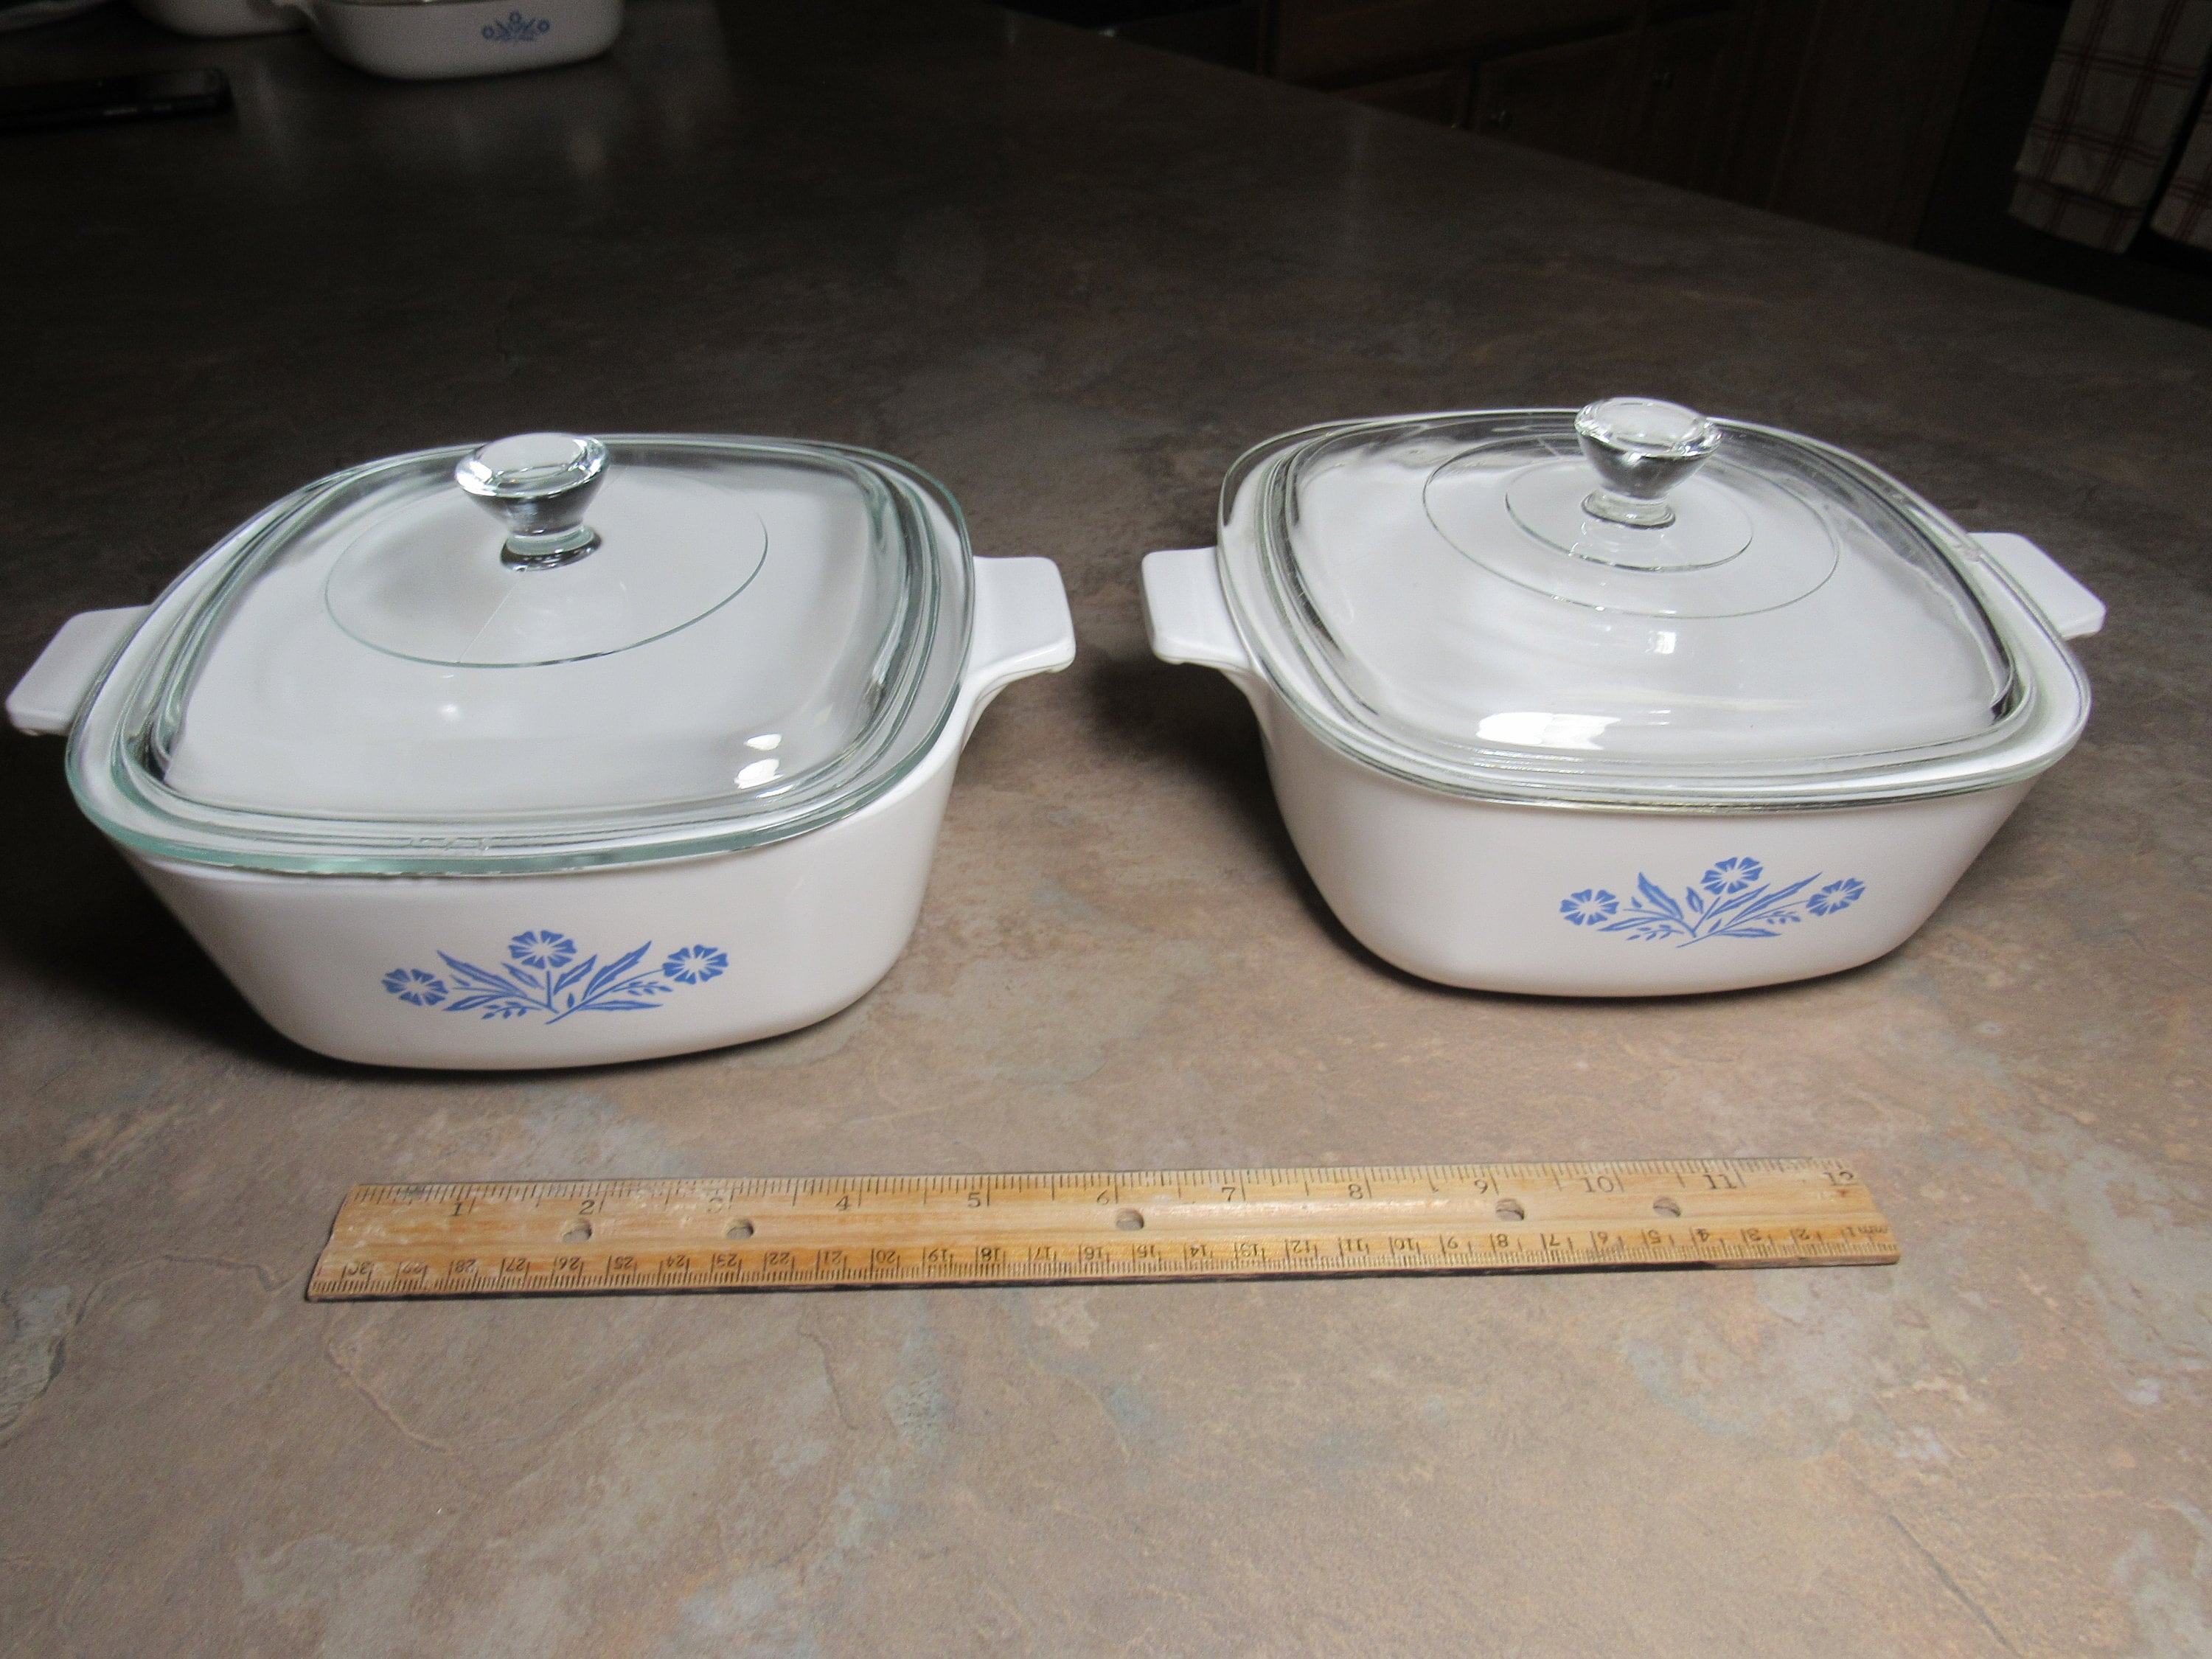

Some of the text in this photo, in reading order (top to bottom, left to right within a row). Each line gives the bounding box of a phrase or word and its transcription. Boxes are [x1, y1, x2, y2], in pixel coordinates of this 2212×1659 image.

[452, 1203, 462, 1216] 1
[579, 1200, 594, 1214] 2
[835, 1195, 849, 1211] 4
[967, 1193, 981, 1208] 5
[1096, 1192, 1110, 1205] 6
[1221, 1187, 1235, 1202] 7
[1348, 1184, 1364, 1200] 8
[1474, 1179, 1489, 1194] 9
[1582, 1177, 1615, 1193] 10
[1704, 1174, 1737, 1189] 11
[1823, 1171, 1855, 1186] 12
[1598, 1231, 1608, 1245] 6
[1649, 1230, 1661, 1244] 5
[1697, 1228, 1709, 1242] 4
[1747, 1228, 1764, 1242] 3
[1798, 1228, 1809, 1240] 2
[1846, 1227, 1856, 1238] 1
[1291, 1239, 1311, 1253] 12
[1345, 1238, 1364, 1252] 11
[1395, 1238, 1416, 1251] 10
[1447, 1236, 1459, 1248] 9
[1497, 1234, 1509, 1247] 8
[1548, 1234, 1560, 1246] 7
[928, 1248, 947, 1262] 19
[981, 1248, 1001, 1261] 18
[1032, 1247, 1051, 1260] 17
[1084, 1246, 1103, 1259] 16
[1137, 1245, 1155, 1258] 15
[1189, 1243, 1208, 1256] 14
[613, 1256, 633, 1265] 25
[717, 1253, 737, 1267] 23
[769, 1253, 790, 1265] 22
[824, 1251, 842, 1263] 21
[875, 1250, 896, 1263] 20
[455, 1259, 475, 1272] 28
[506, 1259, 526, 1271] 27
